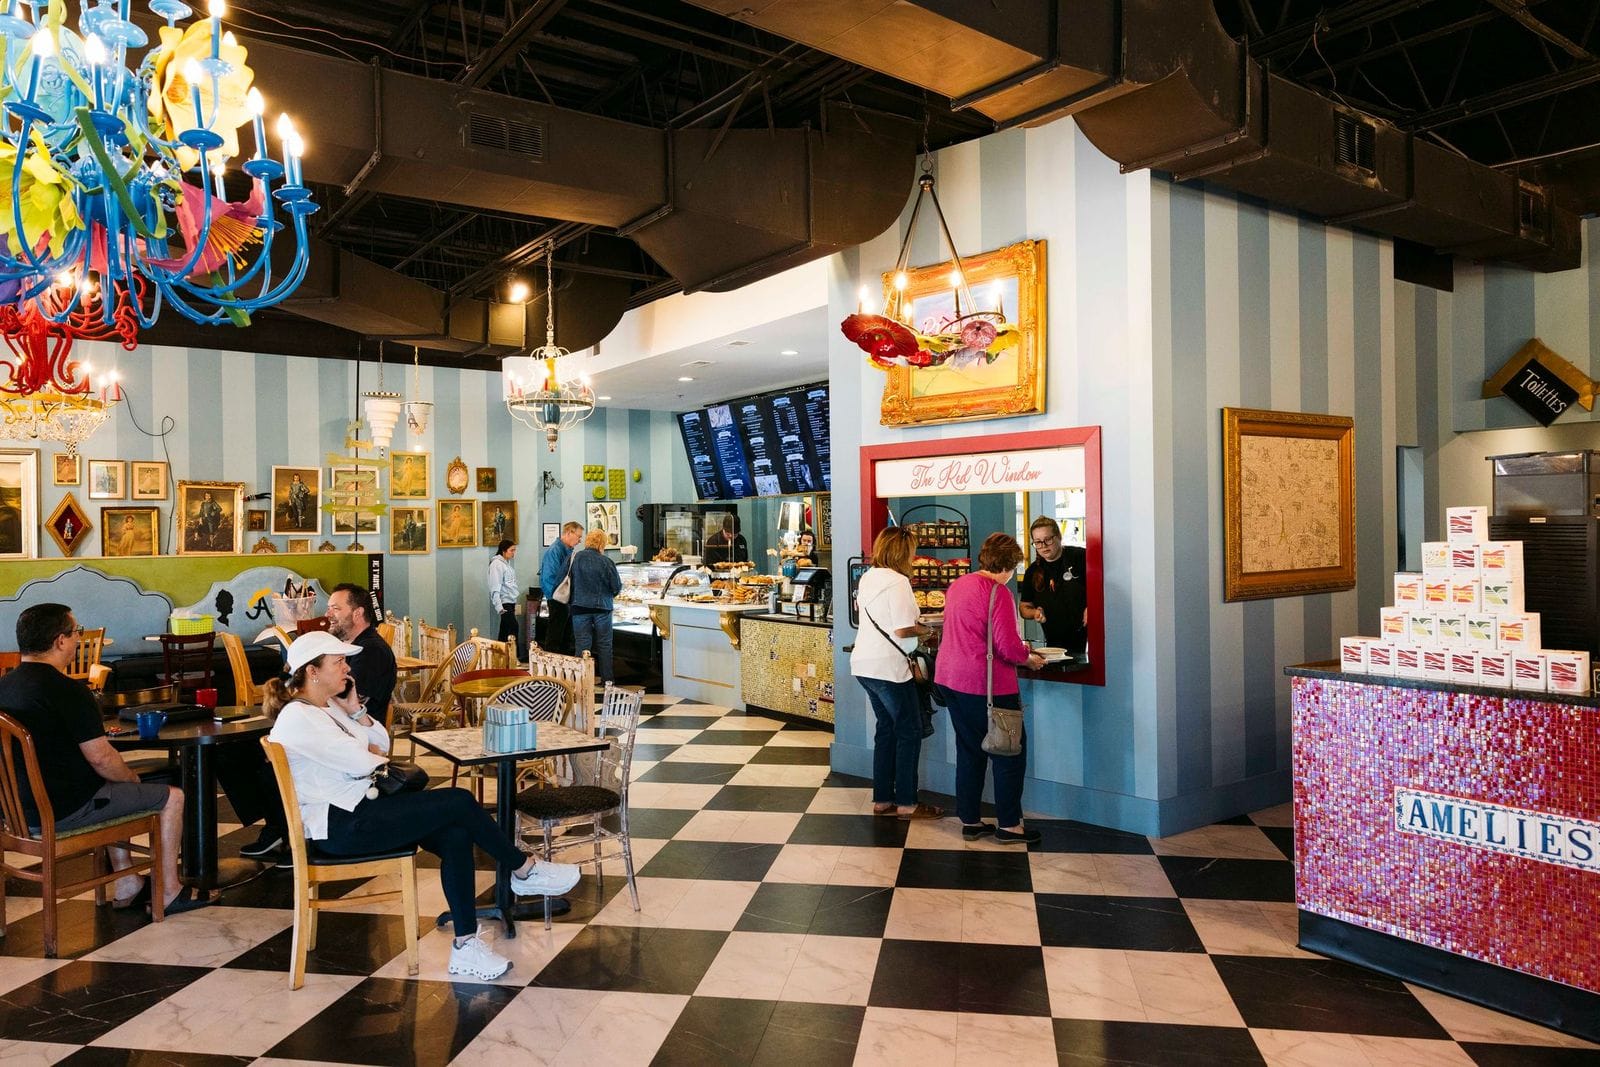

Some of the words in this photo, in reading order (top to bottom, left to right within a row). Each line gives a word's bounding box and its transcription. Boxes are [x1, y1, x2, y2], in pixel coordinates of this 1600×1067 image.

[911, 463, 935, 490] The
[937, 460, 974, 491] Red
[974, 455, 1042, 485] Window
[1408, 798, 1594, 862] AMELIES
